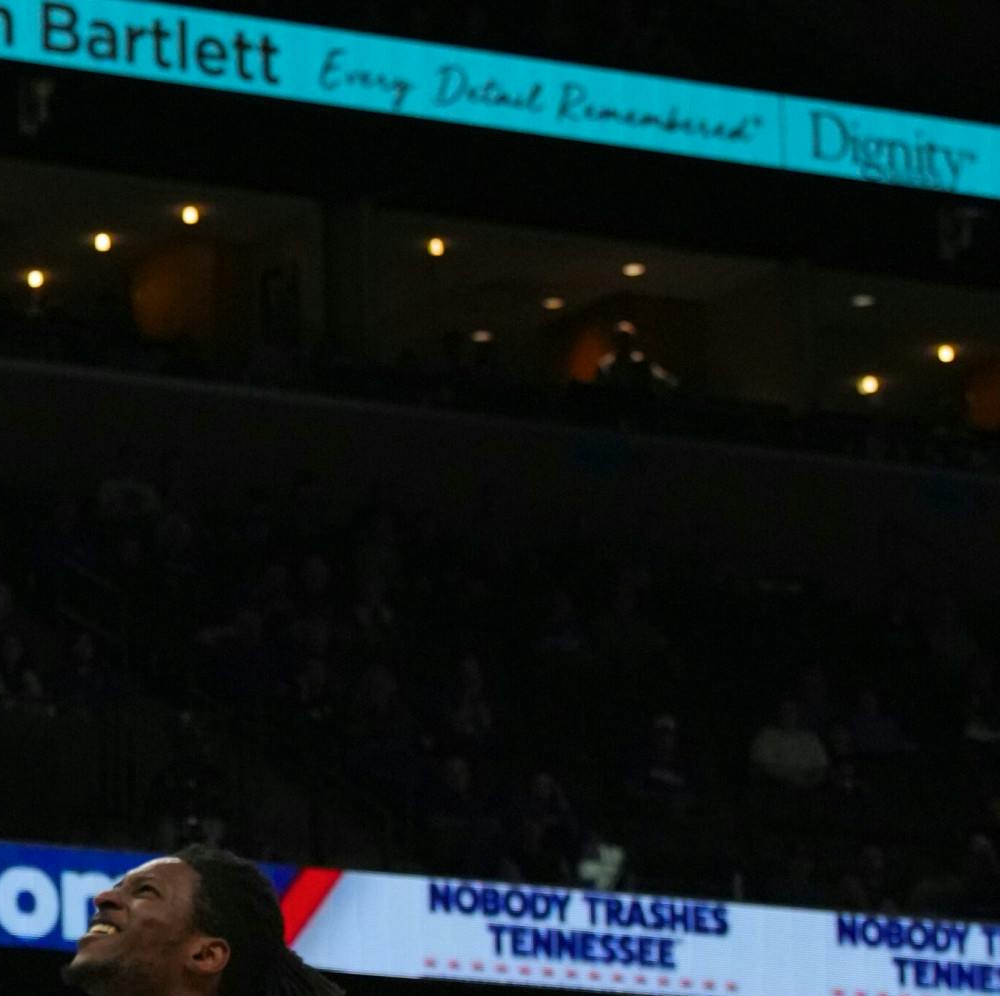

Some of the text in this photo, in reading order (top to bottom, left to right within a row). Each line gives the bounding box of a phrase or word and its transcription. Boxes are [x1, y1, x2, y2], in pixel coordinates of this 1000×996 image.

[42, 2, 279, 85] Bartlett
[319, 47, 412, 111] Every
[434, 64, 543, 113] Detail
[811, 110, 964, 192] Dignity
[430, 883, 727, 935] NOBODY TRASHES
[838, 913, 967, 955] NOBODY
[488, 923, 676, 969] TENNESSEE
[894, 957, 1000, 993] TENNE
